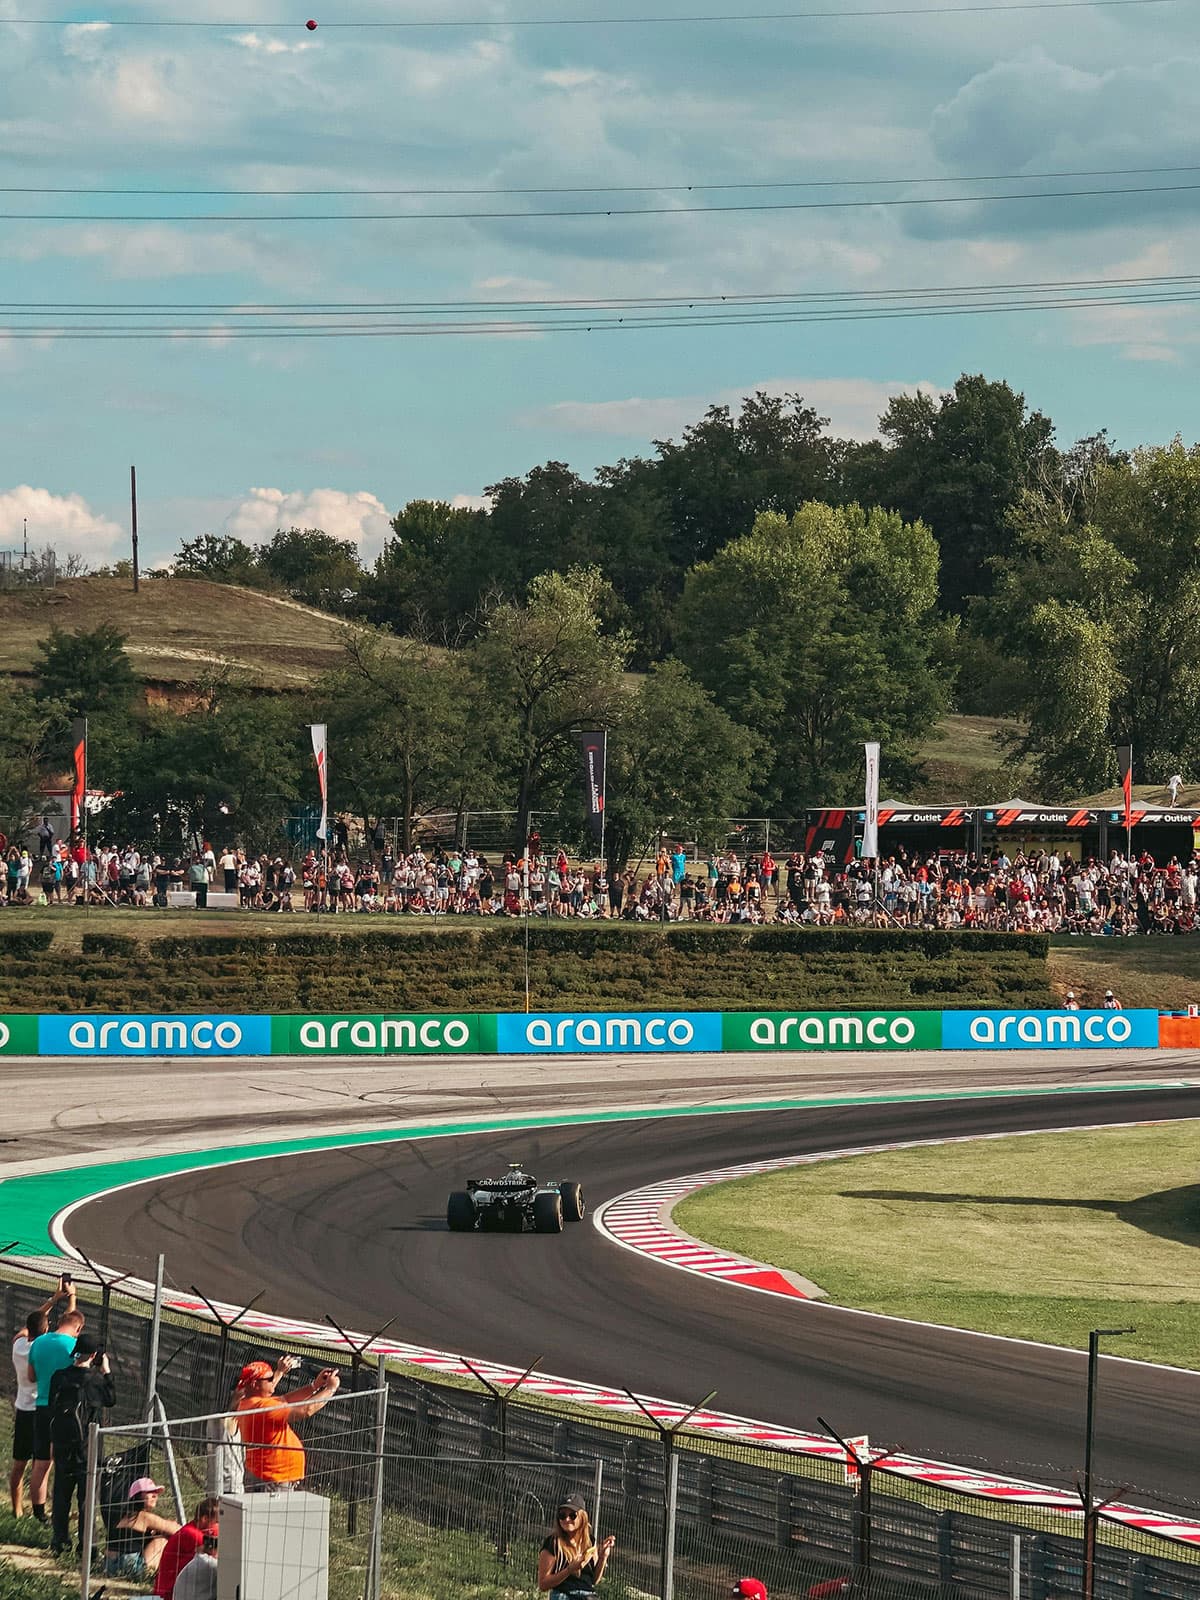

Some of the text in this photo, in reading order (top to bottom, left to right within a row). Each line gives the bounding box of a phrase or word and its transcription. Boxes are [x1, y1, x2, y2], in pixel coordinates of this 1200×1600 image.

[913, 814, 942, 822] Outlet
[1040, 814, 1068, 822] Outlet
[1164, 814, 1193, 823] Outlet
[69, 1021, 242, 1049] aramco
[300, 1020, 470, 1048] aramco
[526, 1019, 694, 1046] aramco
[750, 1017, 915, 1045] aramco
[970, 1015, 1132, 1043] aramco
